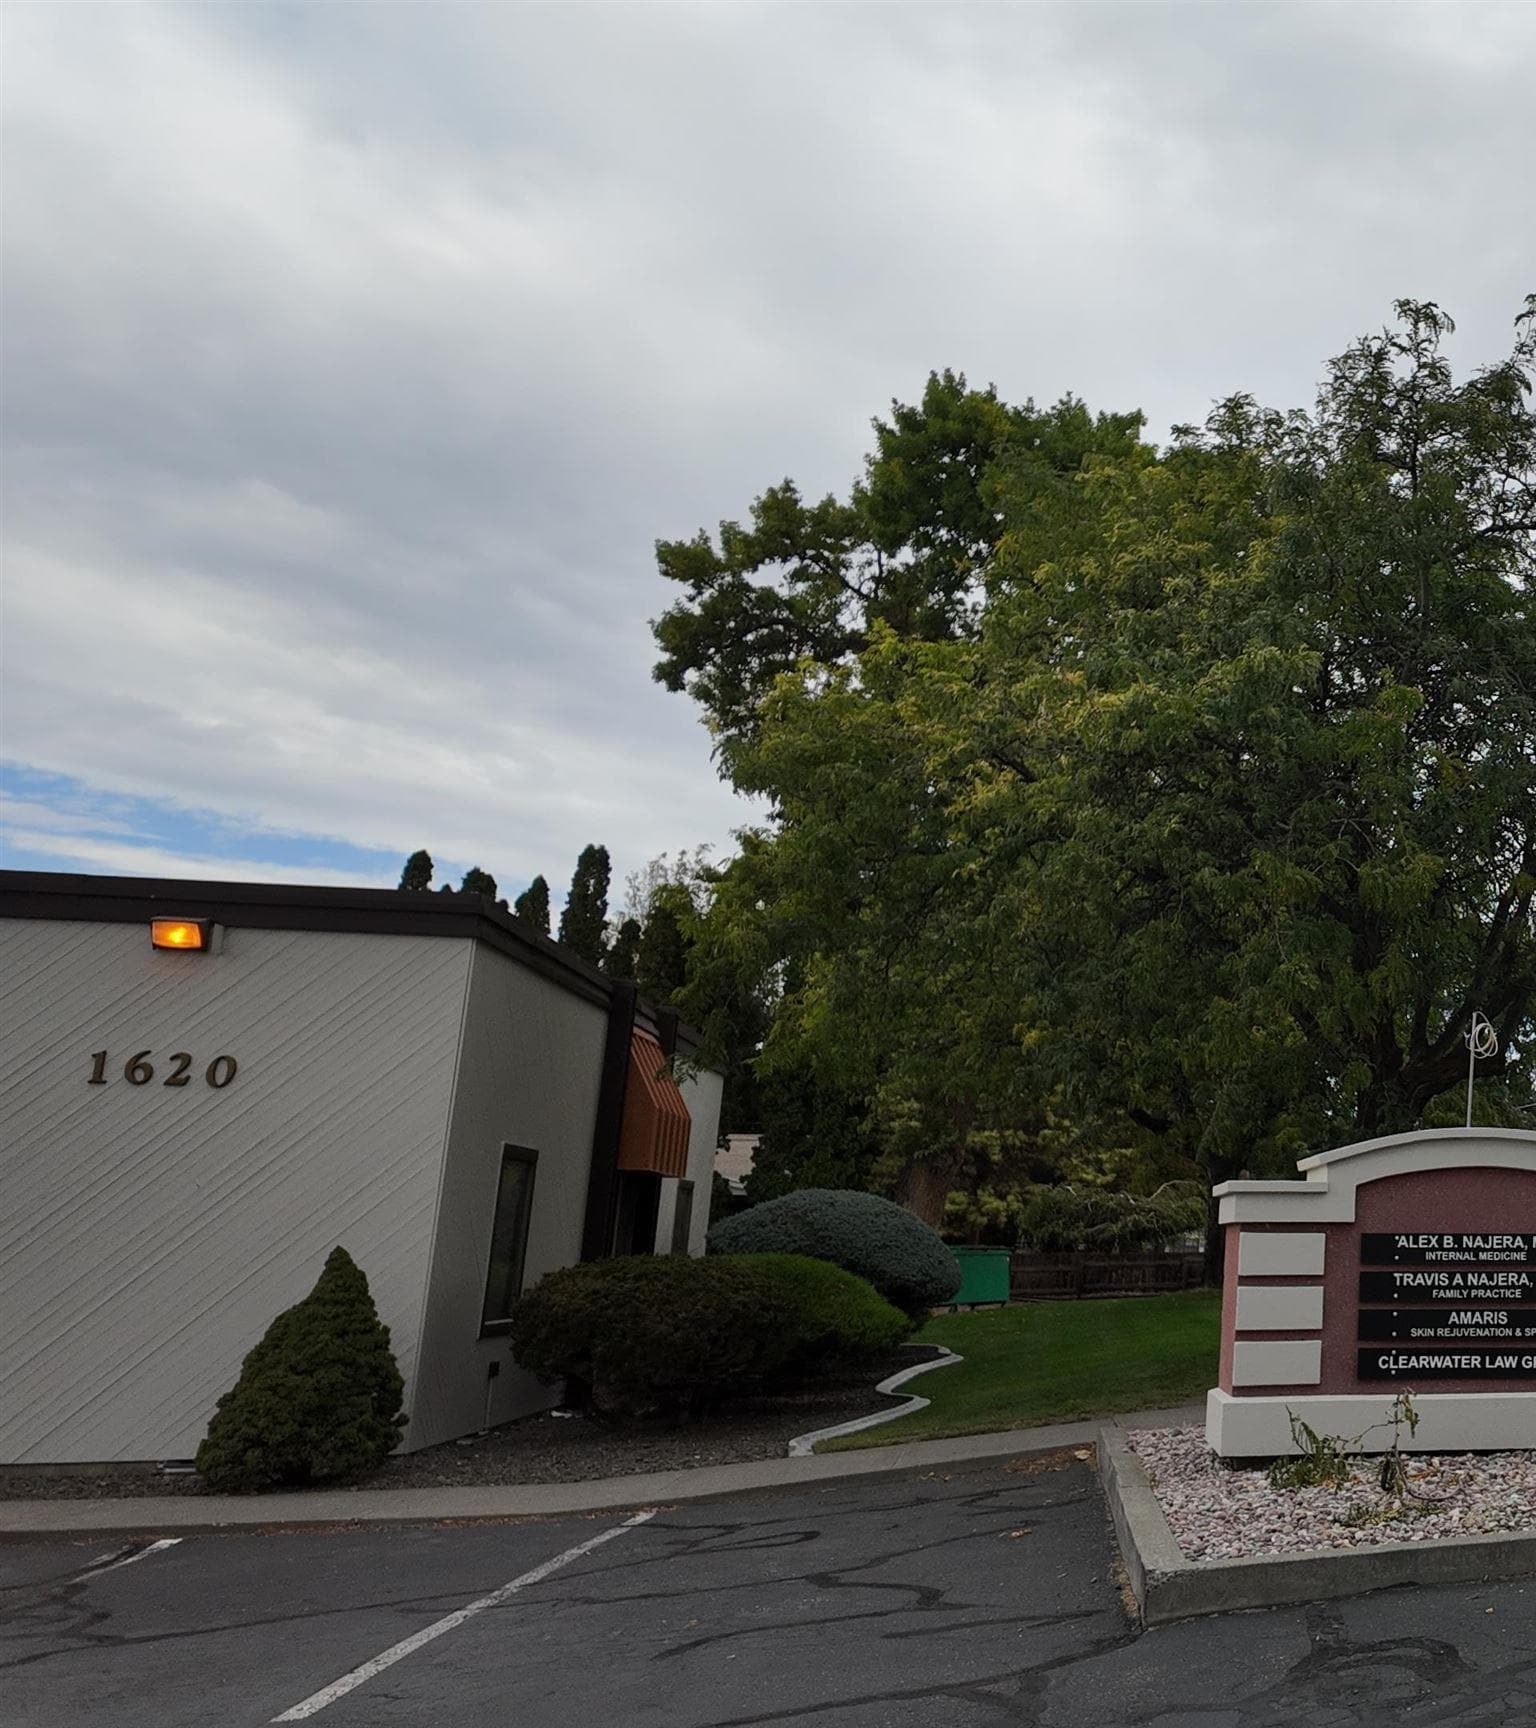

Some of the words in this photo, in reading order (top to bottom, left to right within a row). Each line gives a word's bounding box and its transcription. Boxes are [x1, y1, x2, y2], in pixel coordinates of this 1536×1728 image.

[87, 1050, 238, 1089] 1620
[1397, 1235, 1439, 1248] ALEX
[1443, 1235, 1458, 1248] B.
[1462, 1235, 1528, 1250] NAJERA,
[1425, 1251, 1476, 1261] INTERNAL
[1479, 1251, 1527, 1261] MEDICINE
[1394, 1273, 1449, 1286] TRAVIS
[1452, 1273, 1464, 1286] A
[1467, 1273, 1534, 1288] NAJERA,
[1432, 1289, 1469, 1299] FAMILY
[1471, 1289, 1522, 1299] PRACTICE
[1448, 1311, 1508, 1325] AMARIS
[1410, 1327, 1435, 1337] SKIN
[1437, 1327, 1513, 1337] REJUVENATION
[1515, 1327, 1522, 1337] &
[1378, 1356, 1481, 1369] CLEARWATER
[1485, 1356, 1518, 1369] LAW
